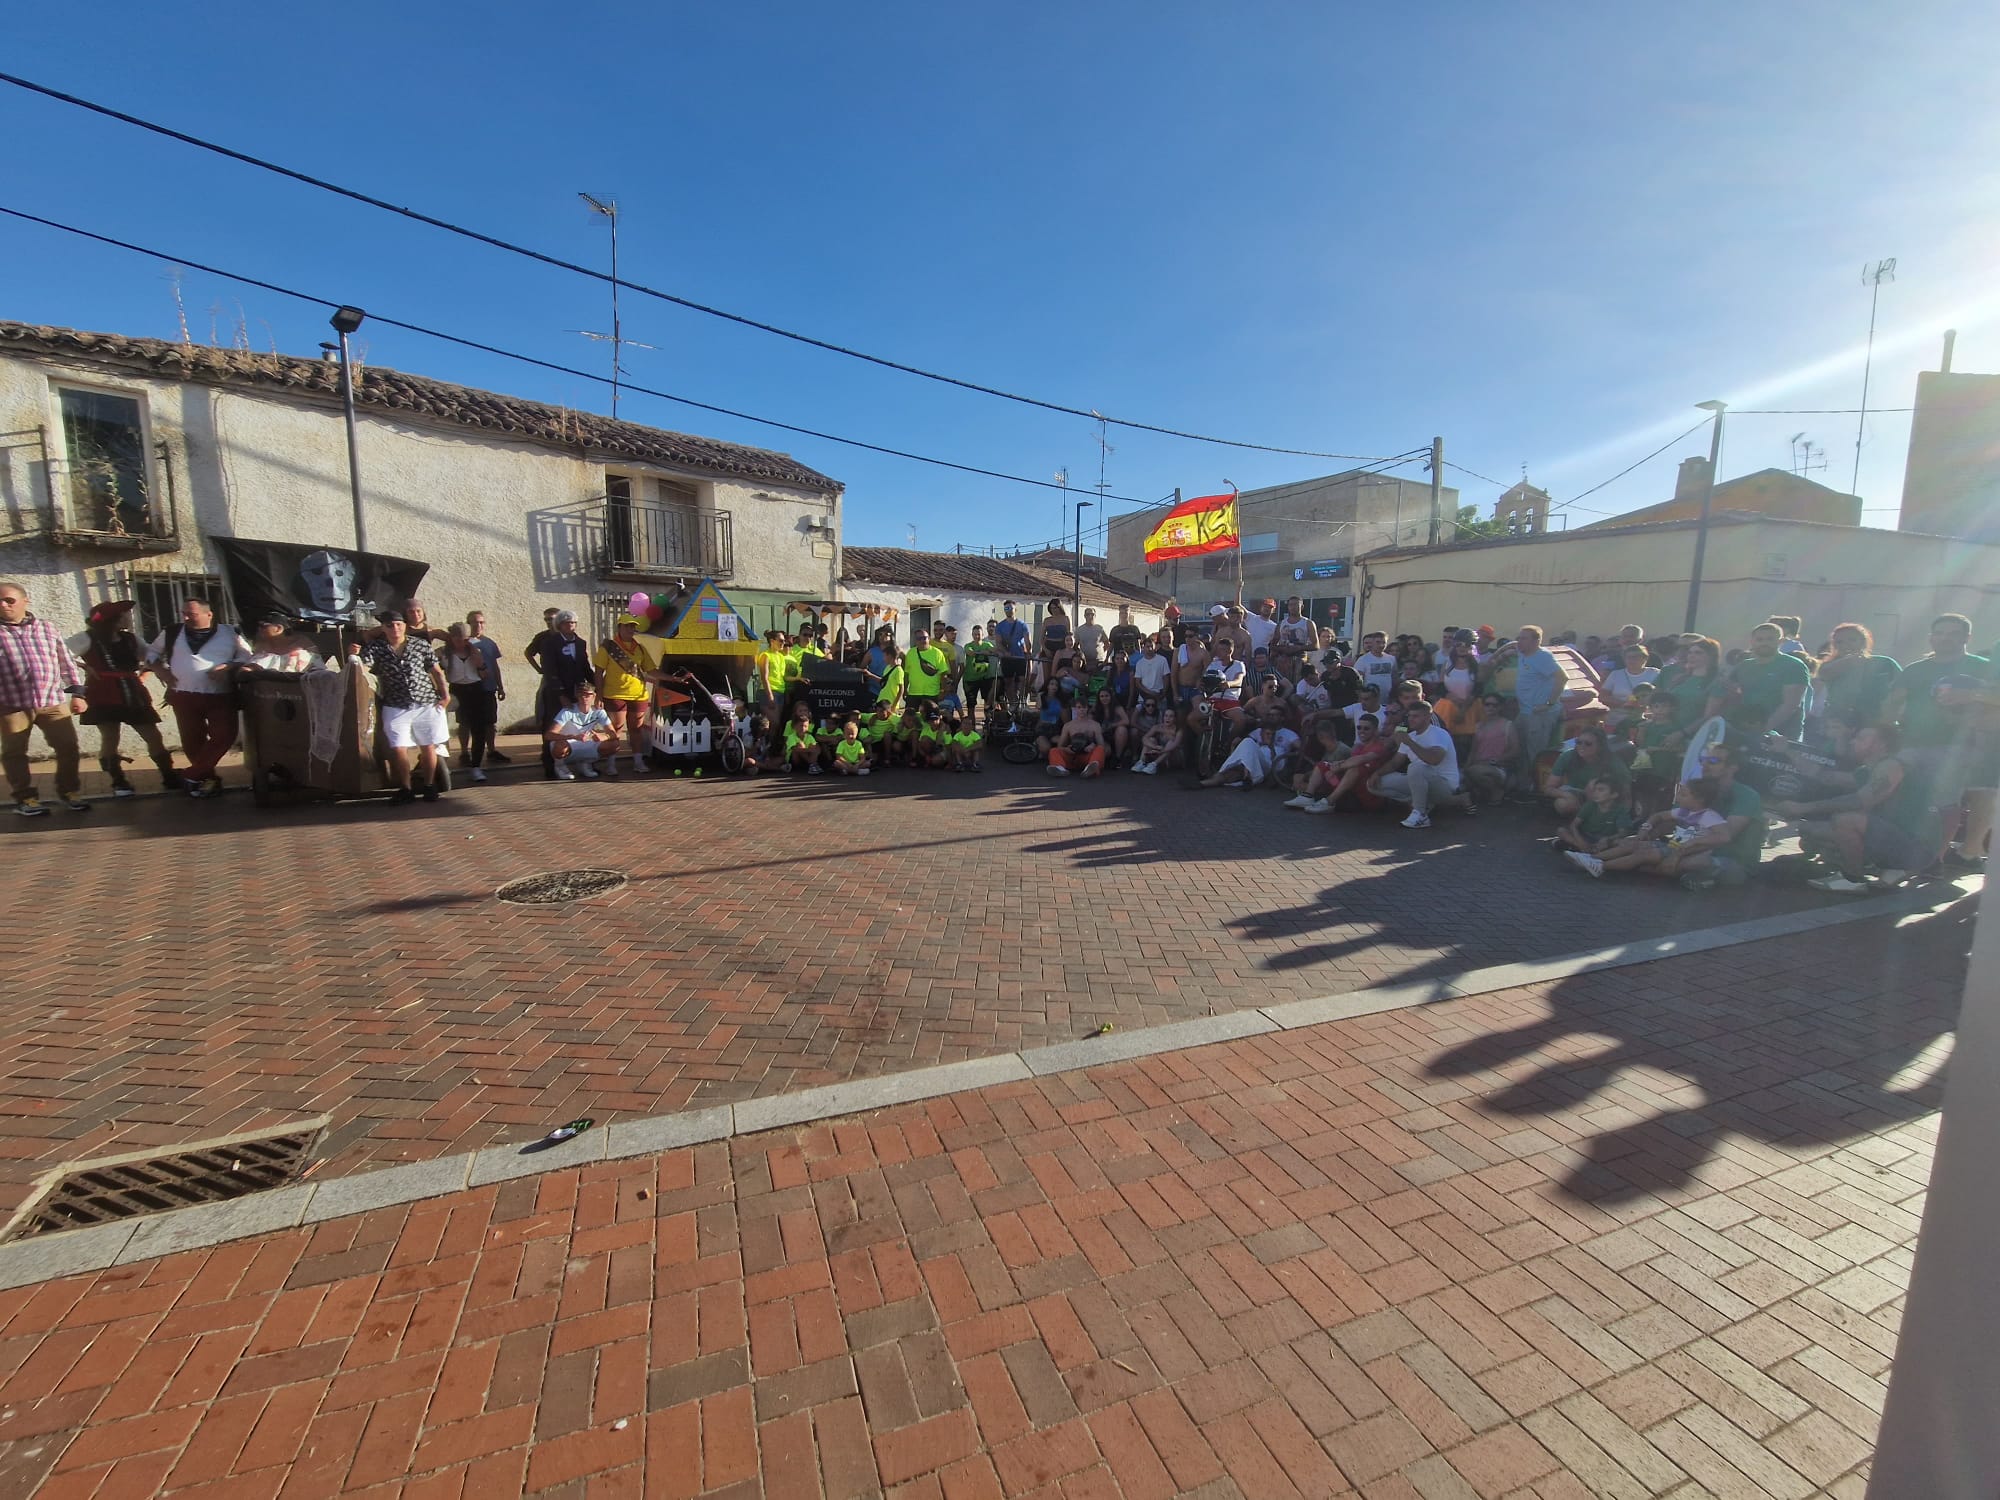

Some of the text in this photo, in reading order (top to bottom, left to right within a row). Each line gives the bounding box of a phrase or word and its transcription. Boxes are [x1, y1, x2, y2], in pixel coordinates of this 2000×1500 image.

[725, 628, 732, 638] 6
[808, 688, 856, 697] ATRACCIONES
[818, 698, 846, 708] LEIVA
